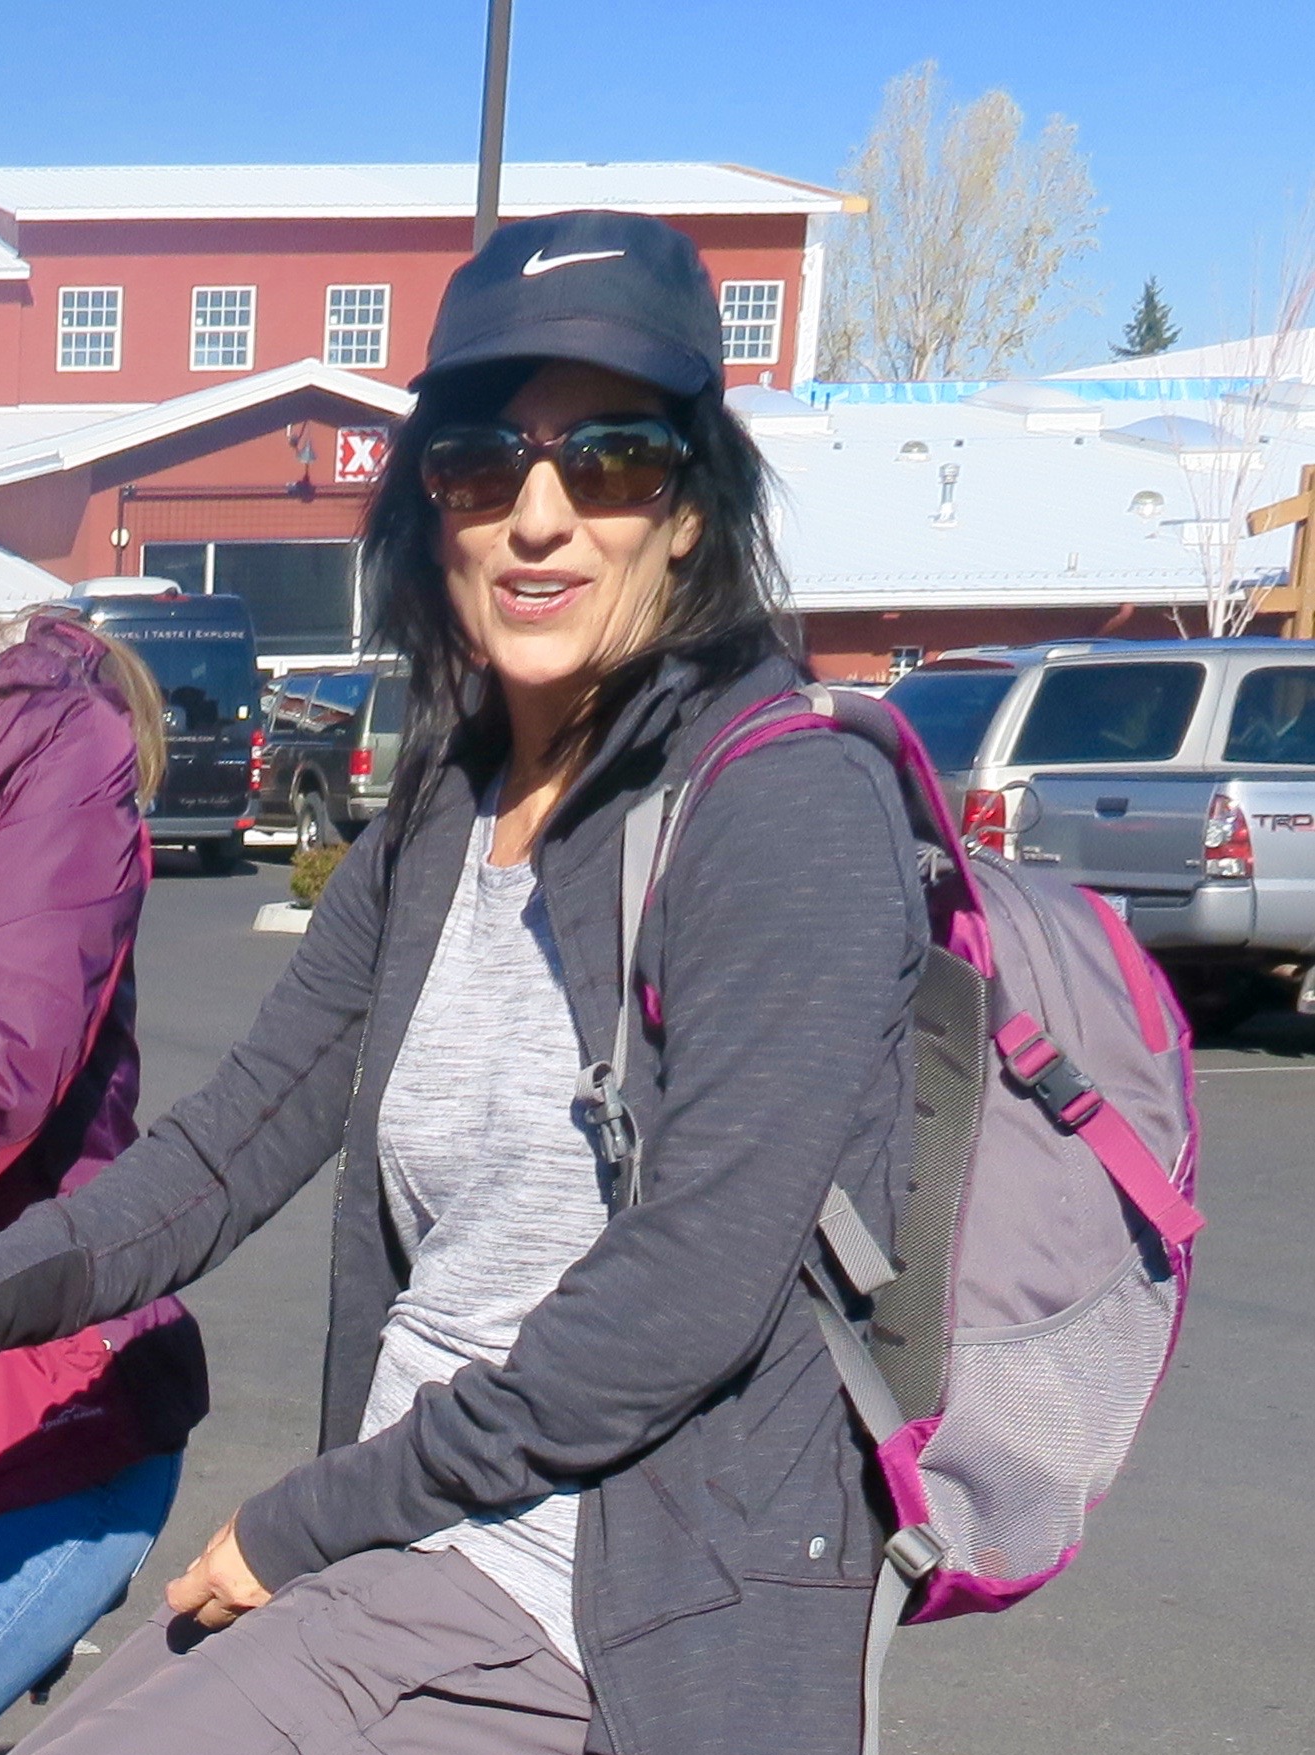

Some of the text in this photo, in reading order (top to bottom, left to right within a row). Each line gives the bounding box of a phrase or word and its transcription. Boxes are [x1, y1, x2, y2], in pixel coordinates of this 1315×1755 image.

[152, 630, 184, 640] TASTE
[194, 630, 246, 640] EXPLORE
[1251, 813, 1314, 832] TRD
